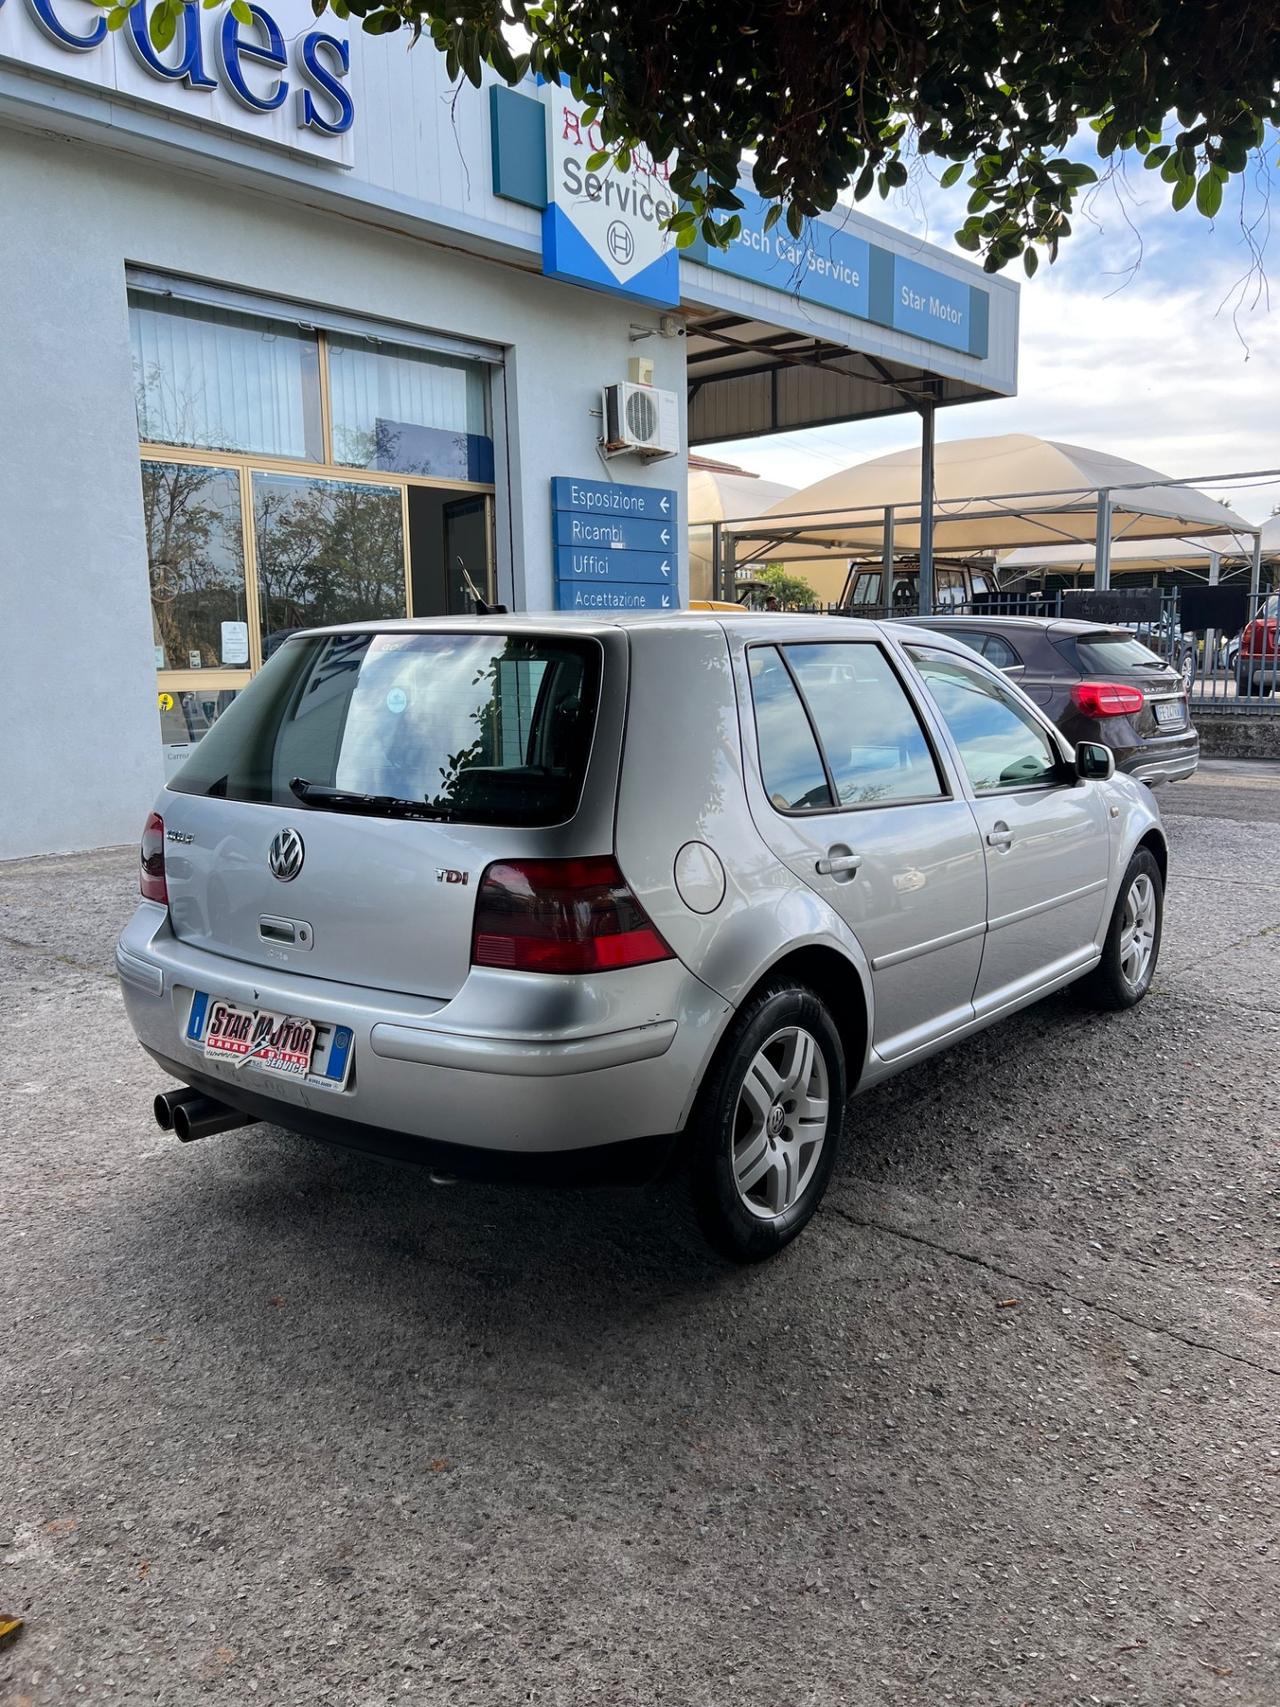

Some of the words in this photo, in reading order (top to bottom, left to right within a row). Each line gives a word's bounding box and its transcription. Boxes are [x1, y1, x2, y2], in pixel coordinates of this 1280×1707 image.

[562, 157, 671, 225] Service
[775, 236, 803, 266] Car
[807, 248, 860, 288] Service
[901, 285, 926, 313] Star
[929, 298, 963, 326] Motor
[571, 486, 645, 511] Esposizione
[572, 520, 623, 542] Ricambi
[573, 555, 609, 574] Uffici
[575, 591, 646, 607] Accettazione
[434, 867, 469, 886] TDI
[211, 1006, 252, 1041] STAR
[265, 1057, 306, 1075] SERVICE
